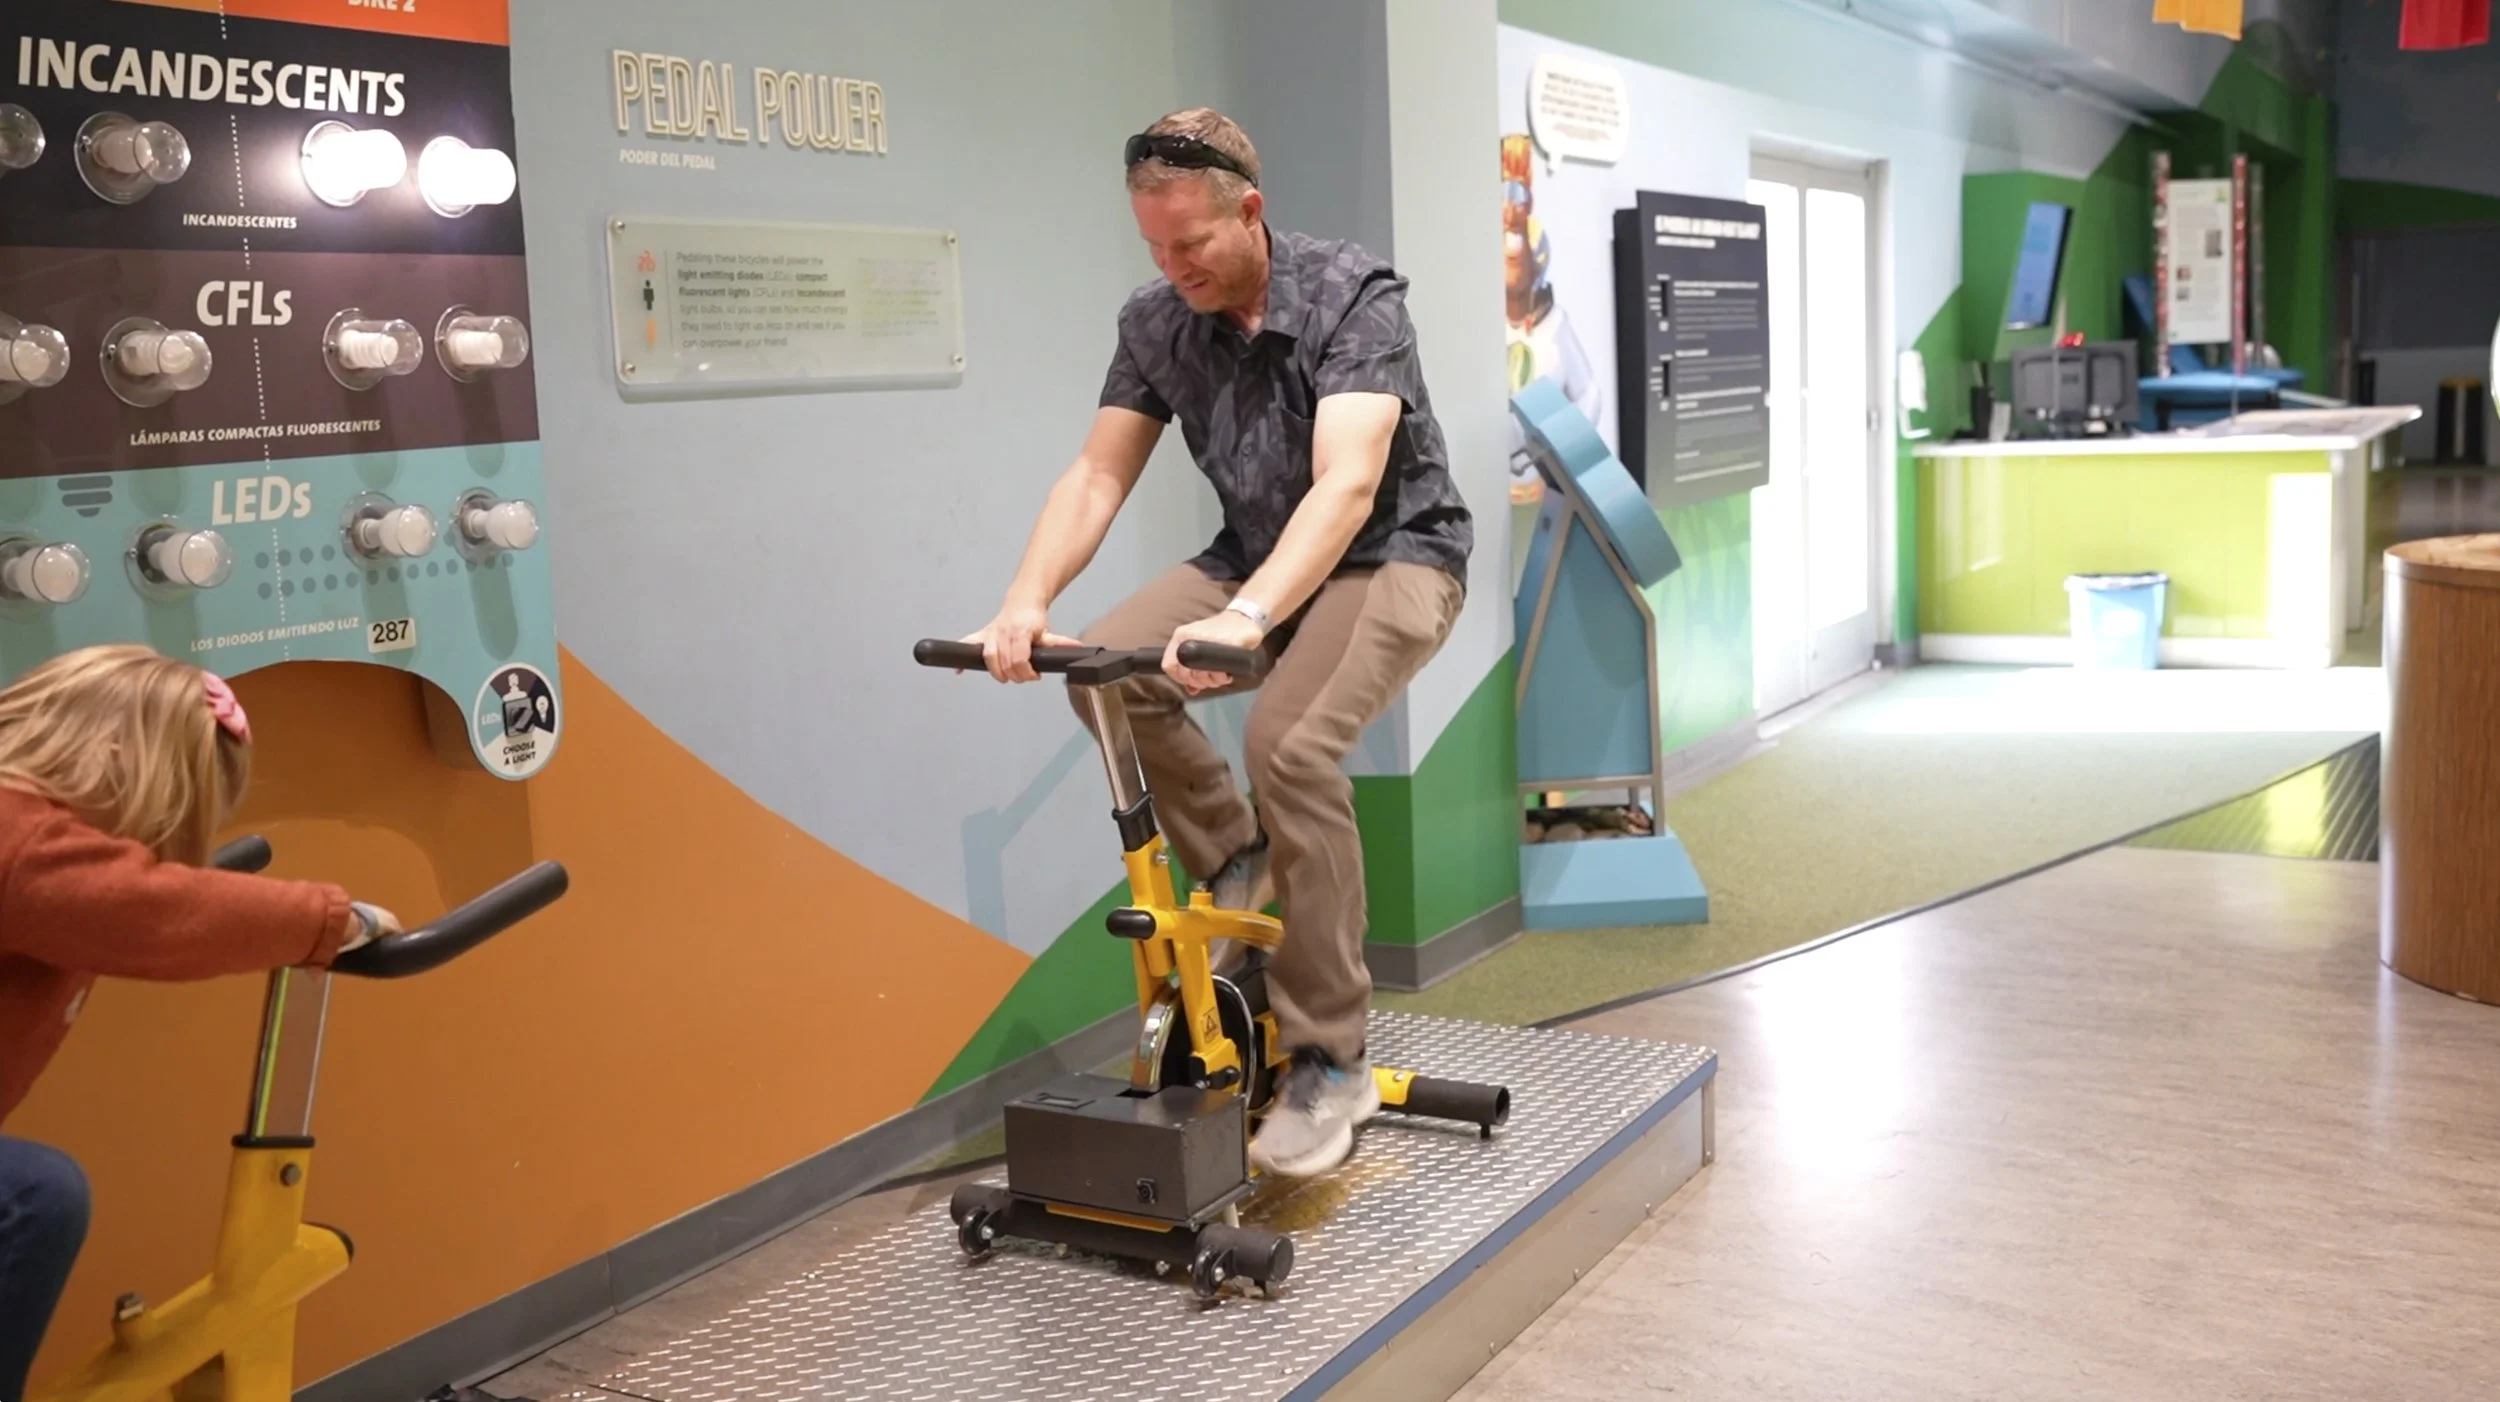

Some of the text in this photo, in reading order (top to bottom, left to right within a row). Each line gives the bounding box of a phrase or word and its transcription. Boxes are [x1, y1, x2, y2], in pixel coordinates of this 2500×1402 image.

[18, 36, 406, 117] INCANDESCENTS
[612, 49, 888, 155] PEDAL POWER
[619, 149, 716, 170] PODER DEL PEDAL
[182, 212, 298, 229] INCANDESCENTES
[196, 280, 293, 327] CFLs
[130, 418, 382, 446] LÁMPARAS COMPACTAS FLUORESCENTES
[211, 475, 312, 526] LEDs
[190, 615, 360, 653] LOS DIODOS EMITIENDO LUZ
[371, 618, 410, 645] 287
[502, 740, 537, 755] CHOOSE
[504, 751, 537, 766] A LIGHT
